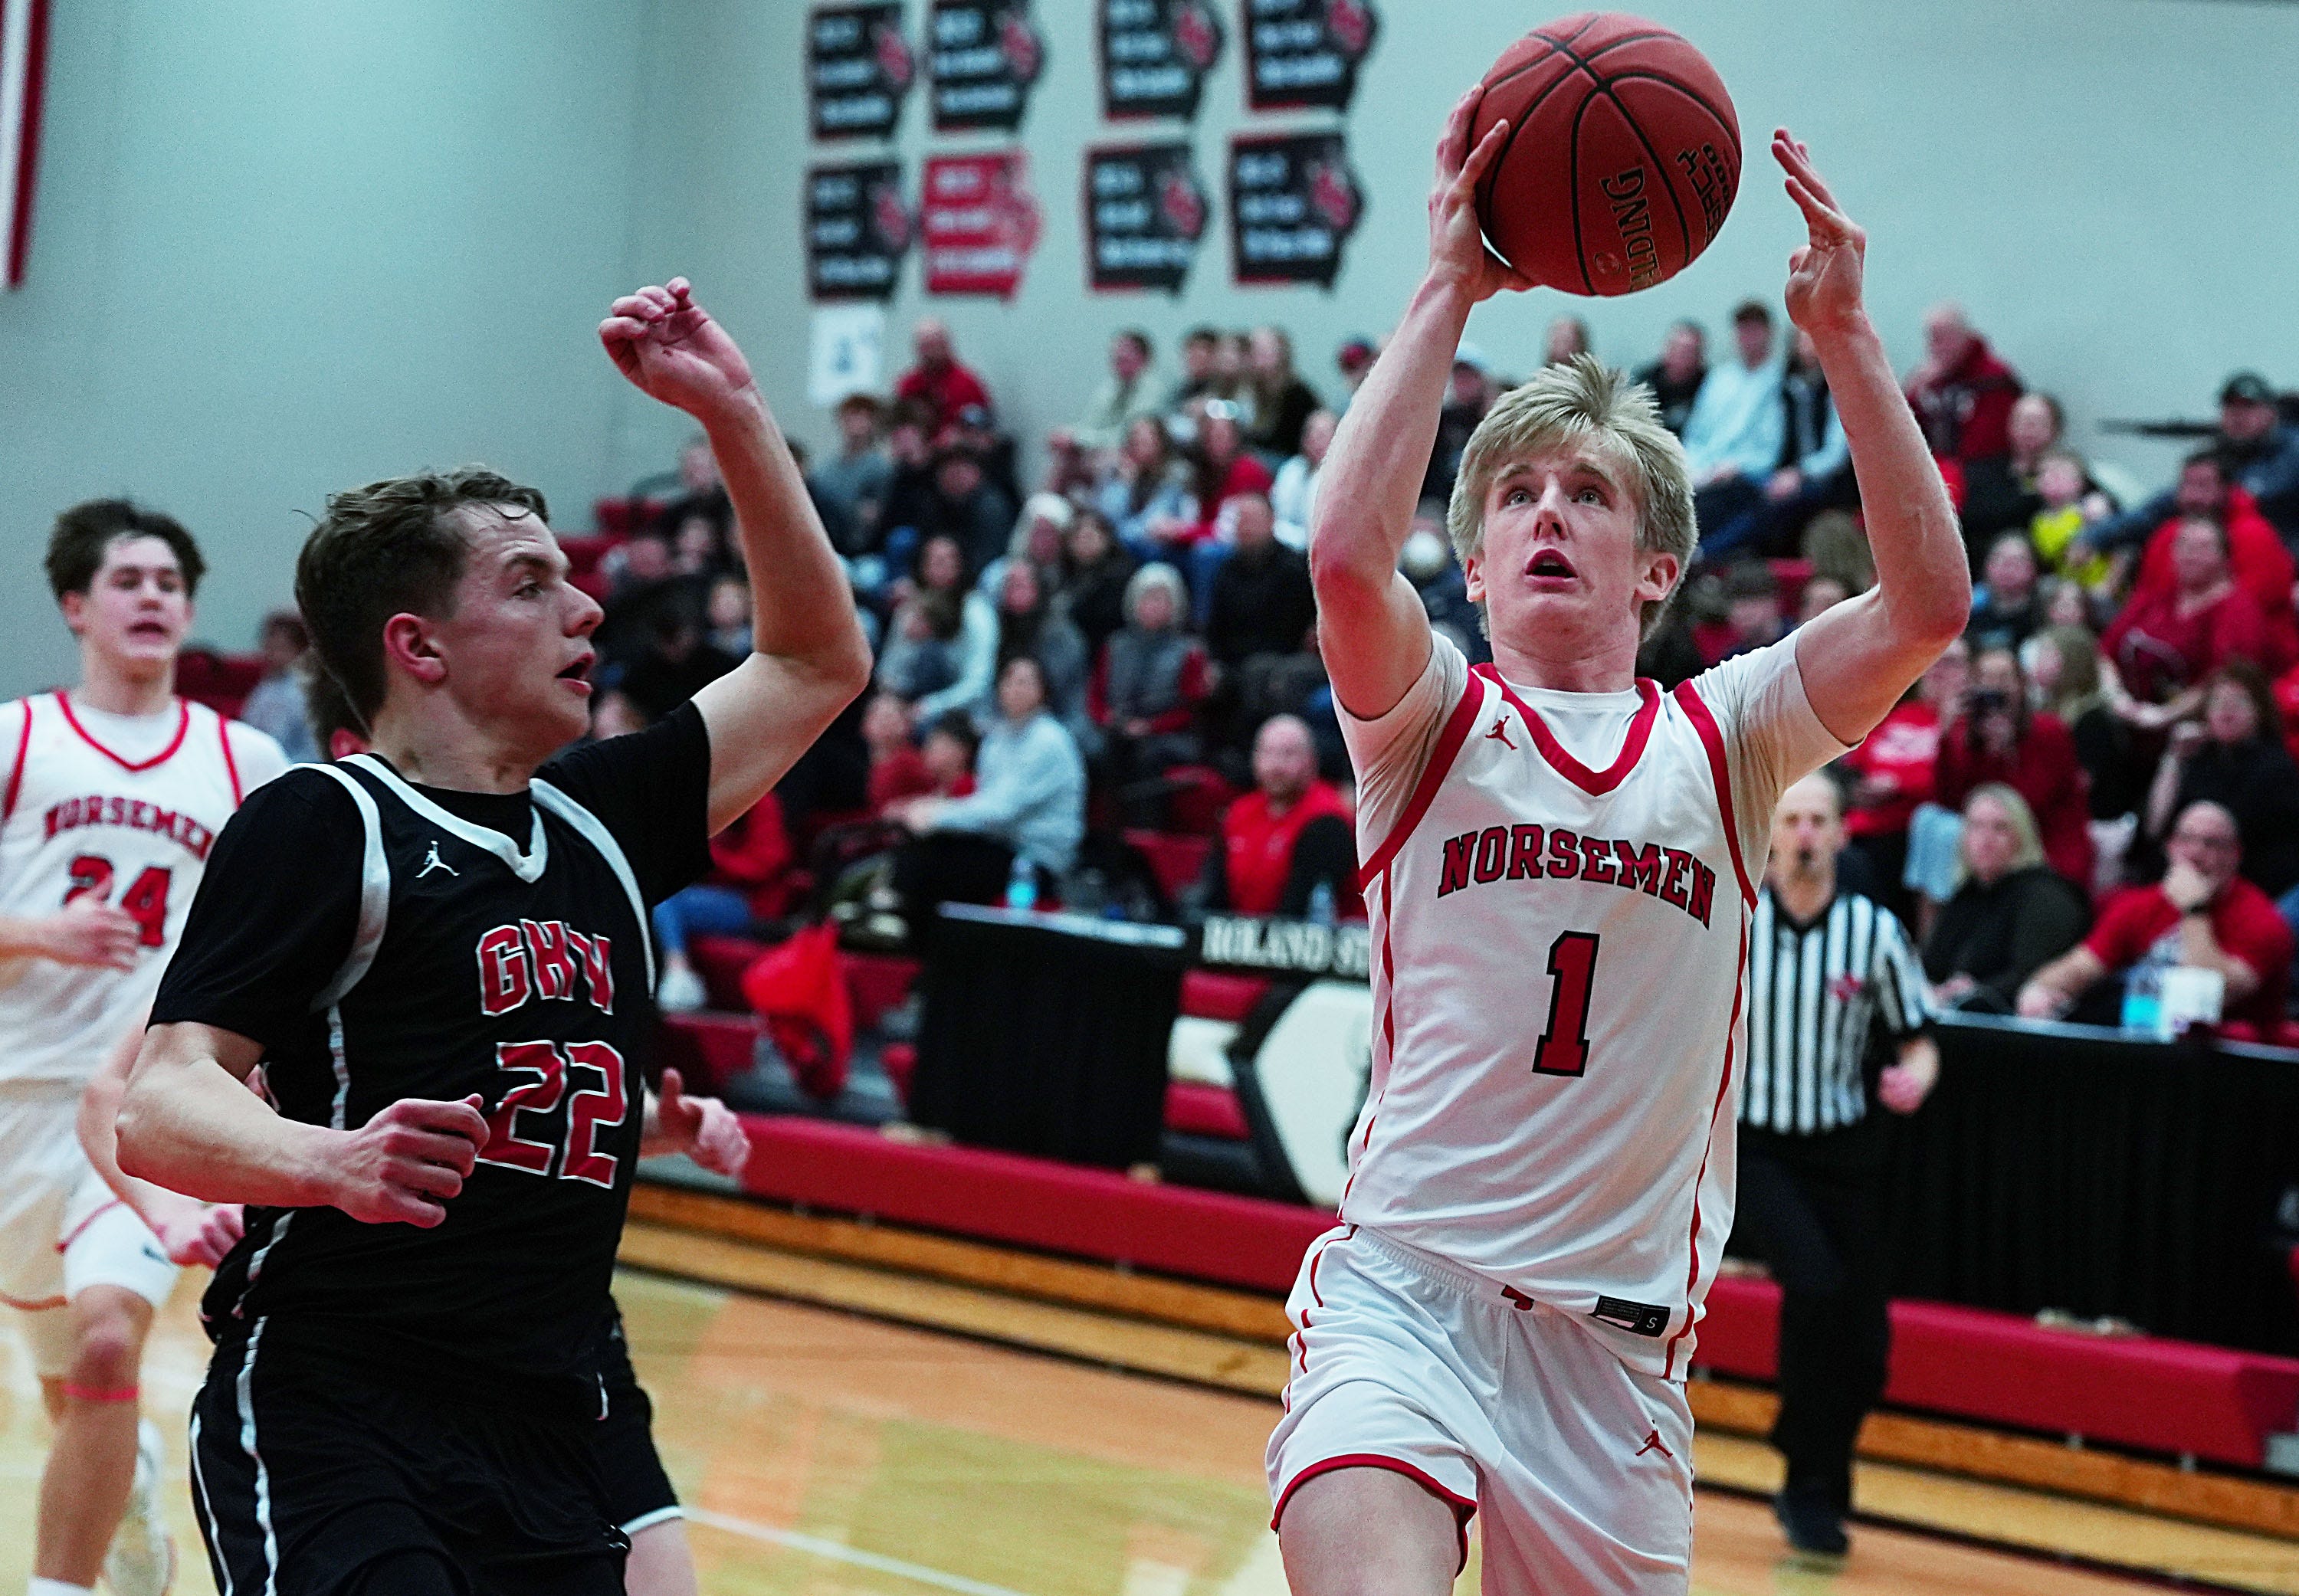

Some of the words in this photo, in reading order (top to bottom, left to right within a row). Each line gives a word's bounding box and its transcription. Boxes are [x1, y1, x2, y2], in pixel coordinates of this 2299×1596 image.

[1437, 824, 1717, 930] NORSEMEN
[475, 918, 615, 1016] GHV
[1532, 929, 1601, 1078] 1
[474, 1039, 629, 1190] 22
[1645, 1316, 1658, 1329] S
